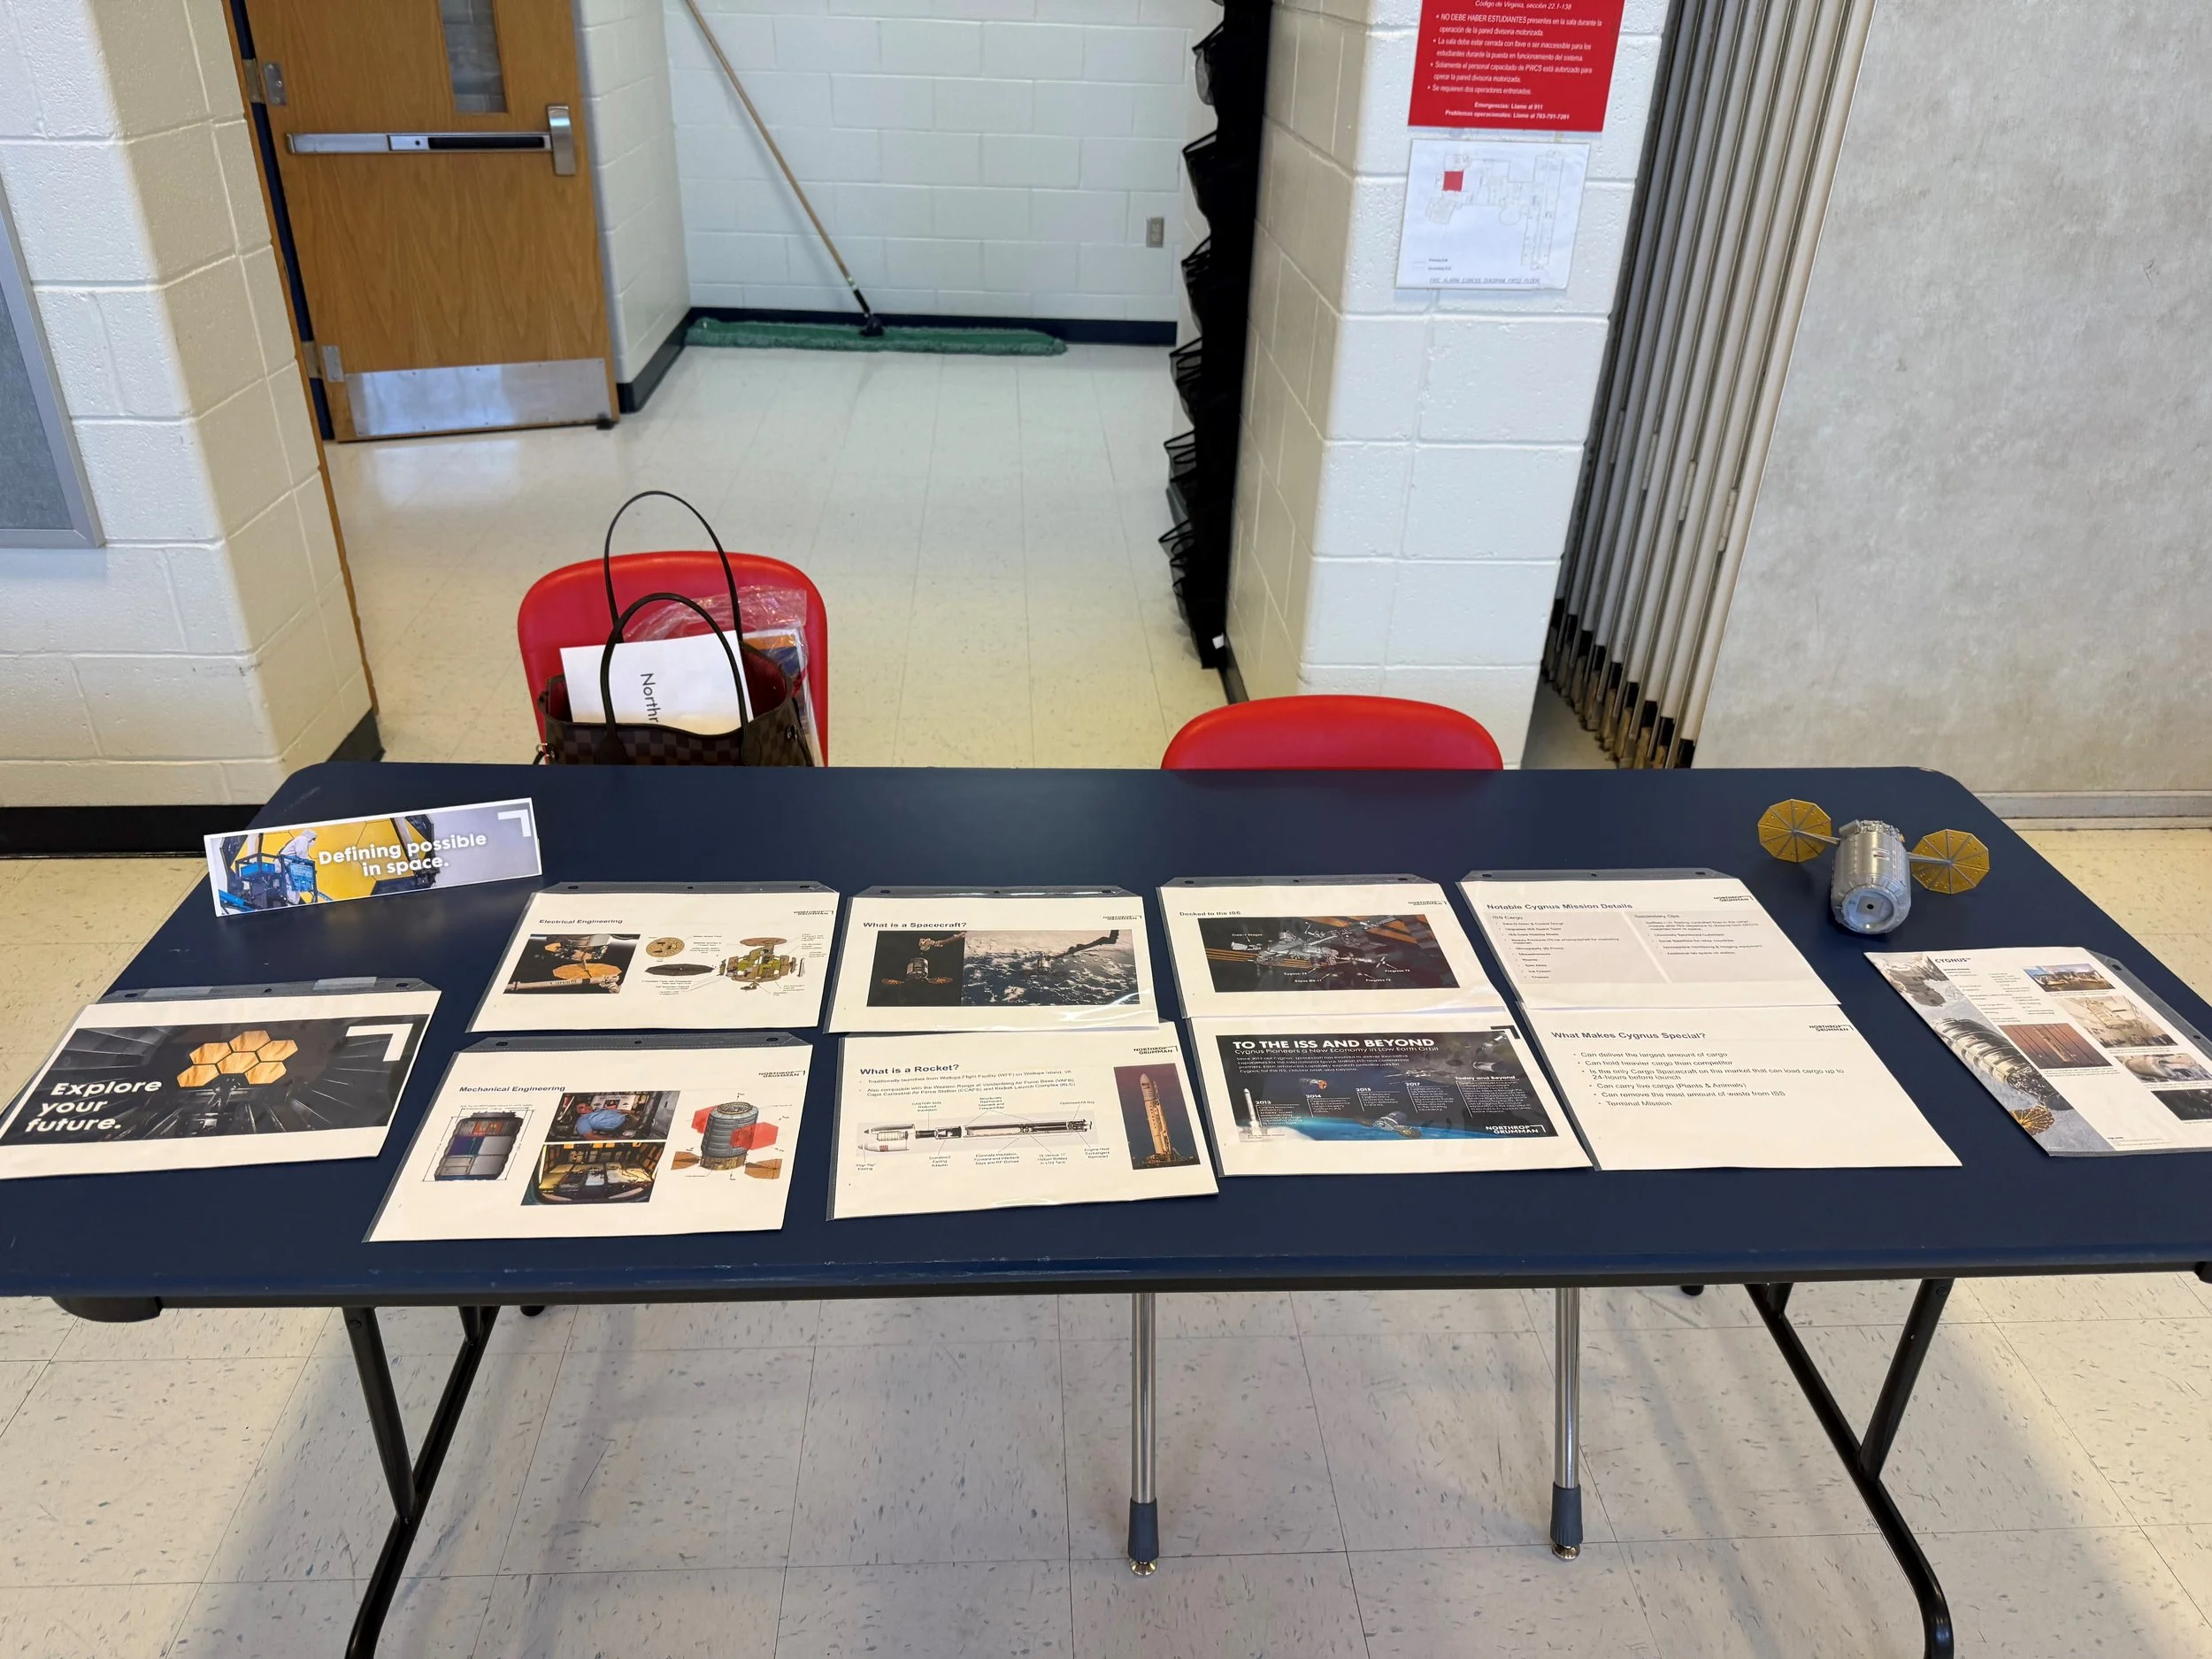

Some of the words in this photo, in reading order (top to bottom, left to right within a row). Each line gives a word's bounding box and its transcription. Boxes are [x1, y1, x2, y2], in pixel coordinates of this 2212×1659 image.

[318, 841, 402, 866] Defining
[407, 833, 487, 856] possible
[362, 861, 381, 877] in
[387, 856, 449, 875] space.
[1364, 1039, 1435, 1047] BEYOND
[50, 1079, 162, 1096] Explore
[40, 1098, 108, 1118] your
[25, 1115, 122, 1134] future.
